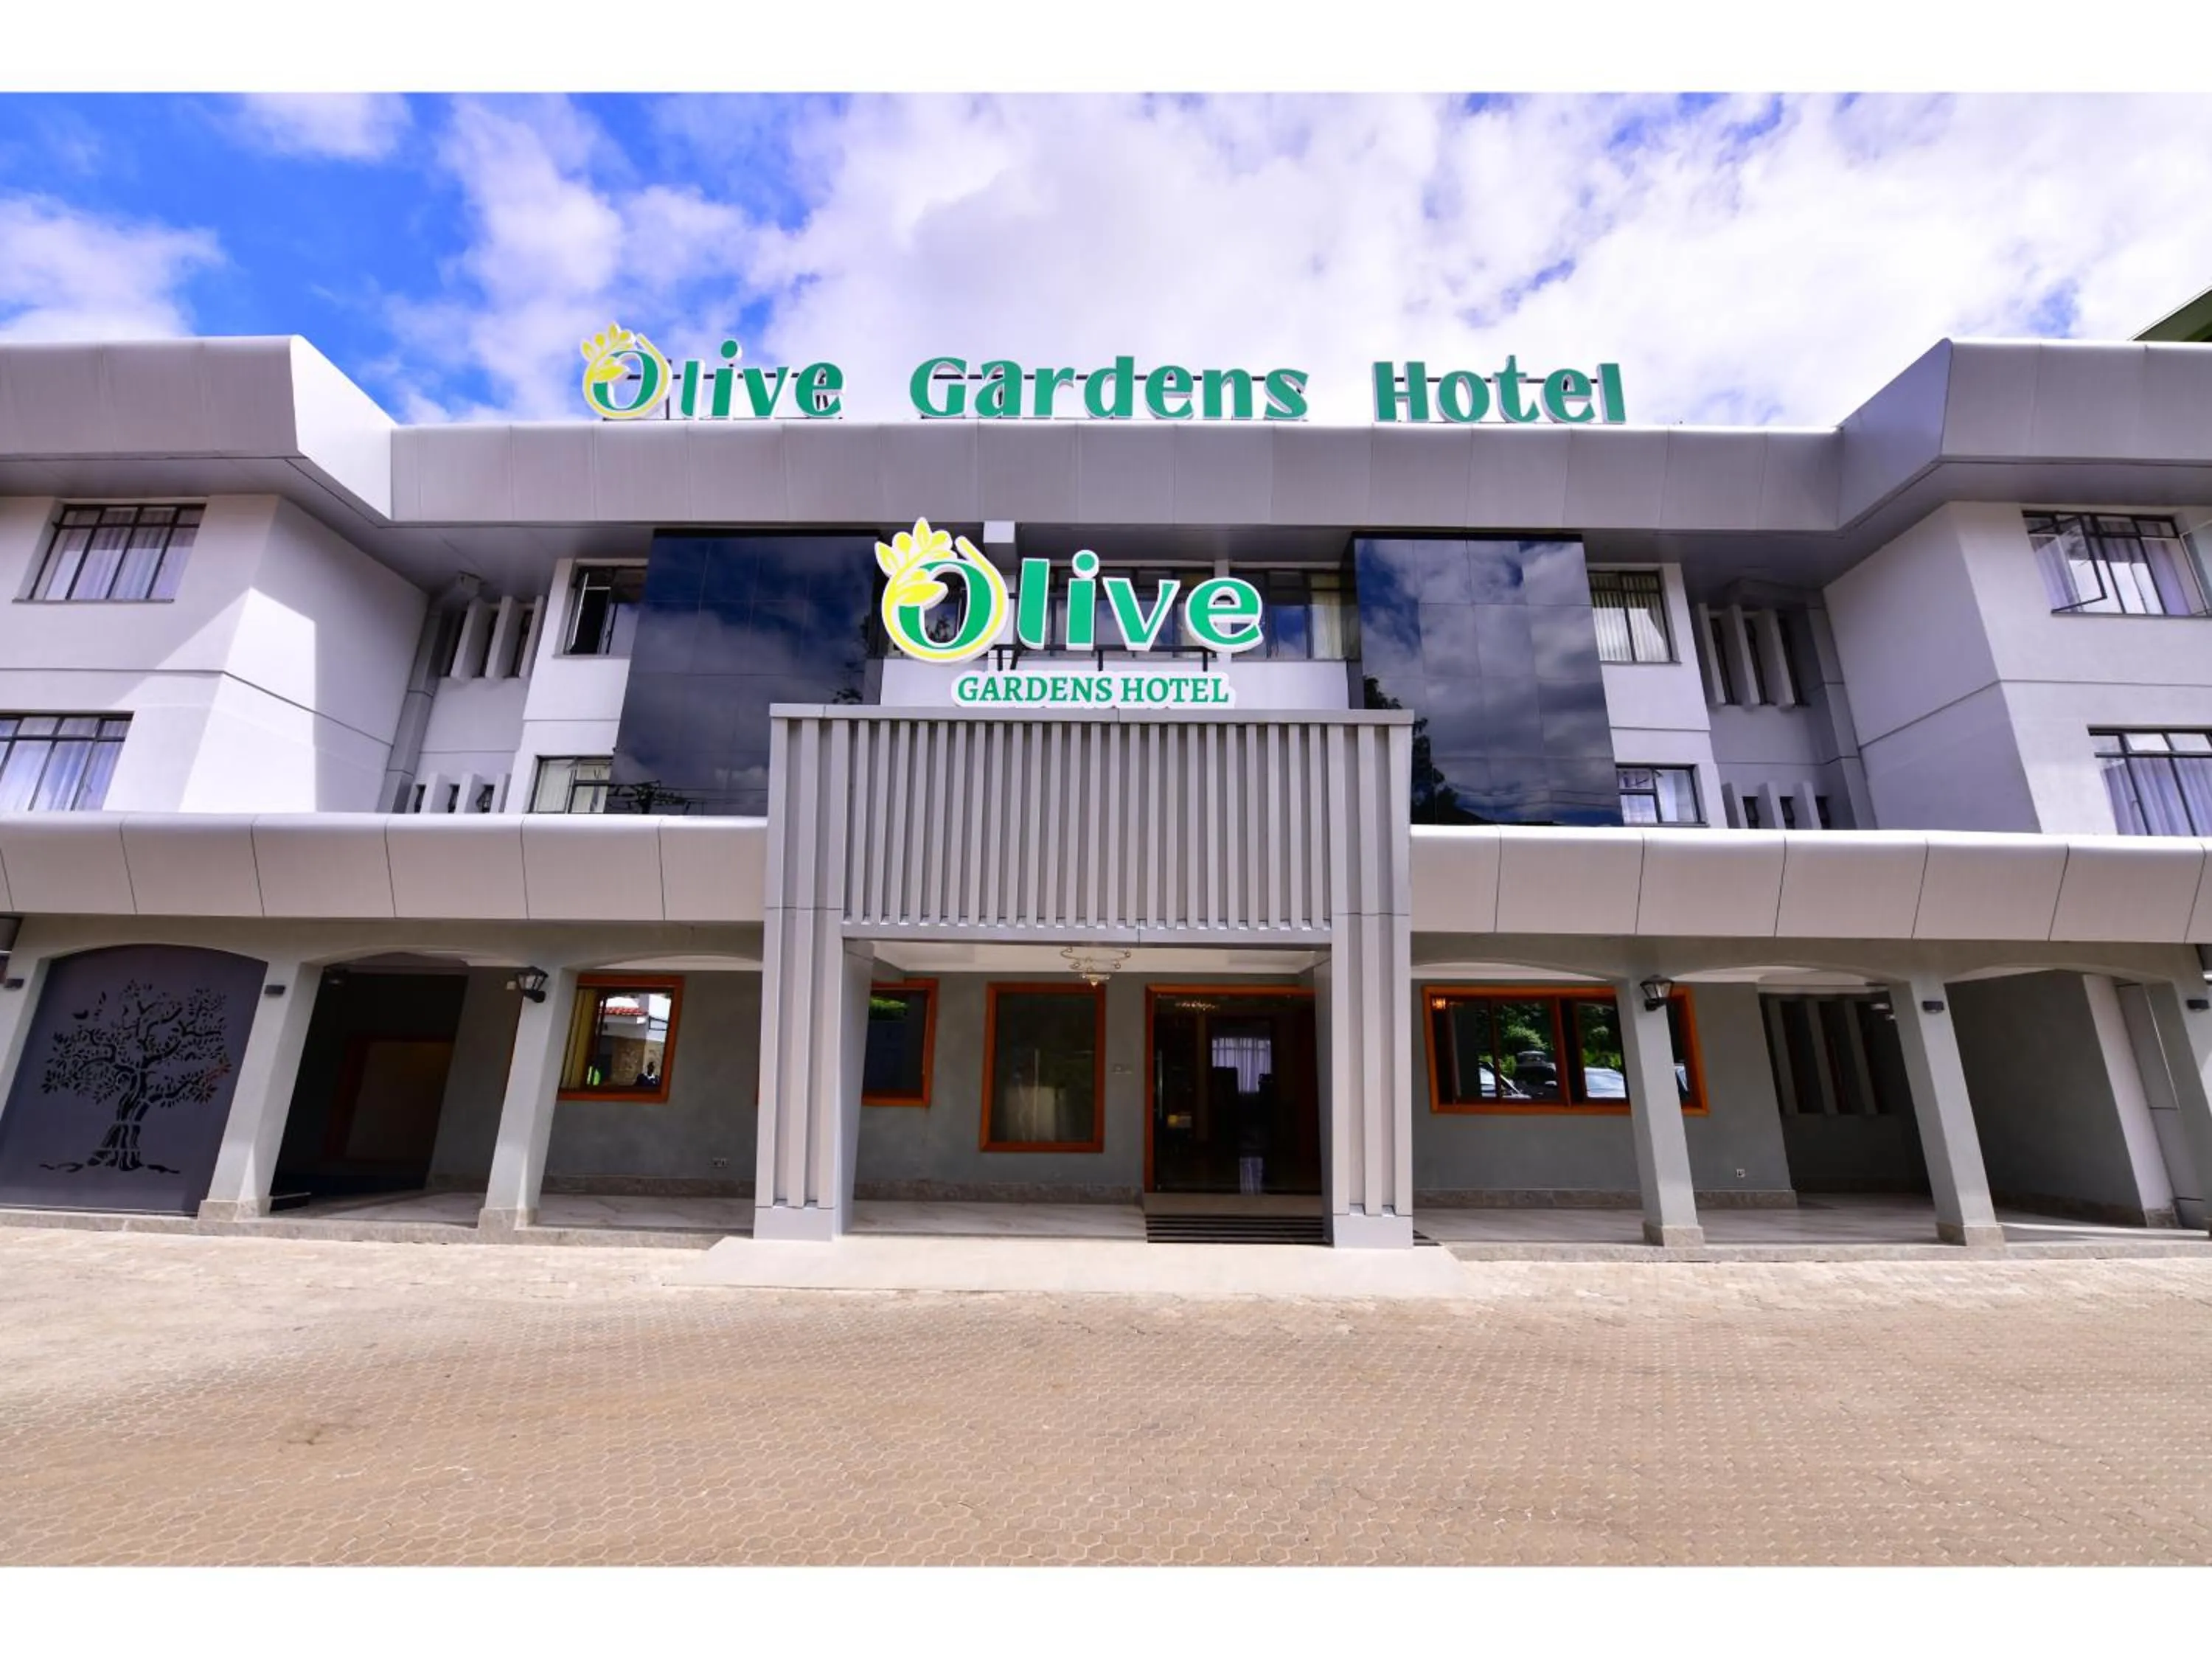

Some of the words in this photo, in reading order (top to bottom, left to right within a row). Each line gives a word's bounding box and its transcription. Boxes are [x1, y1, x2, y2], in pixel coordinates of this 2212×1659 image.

[583, 338, 845, 418] Olive
[910, 355, 1310, 419] Gardens
[1372, 355, 1627, 423] Hotel
[883, 549, 1263, 662] Olive
[957, 676, 1113, 703] GARDENS
[1119, 676, 1230, 704] HOTEL
